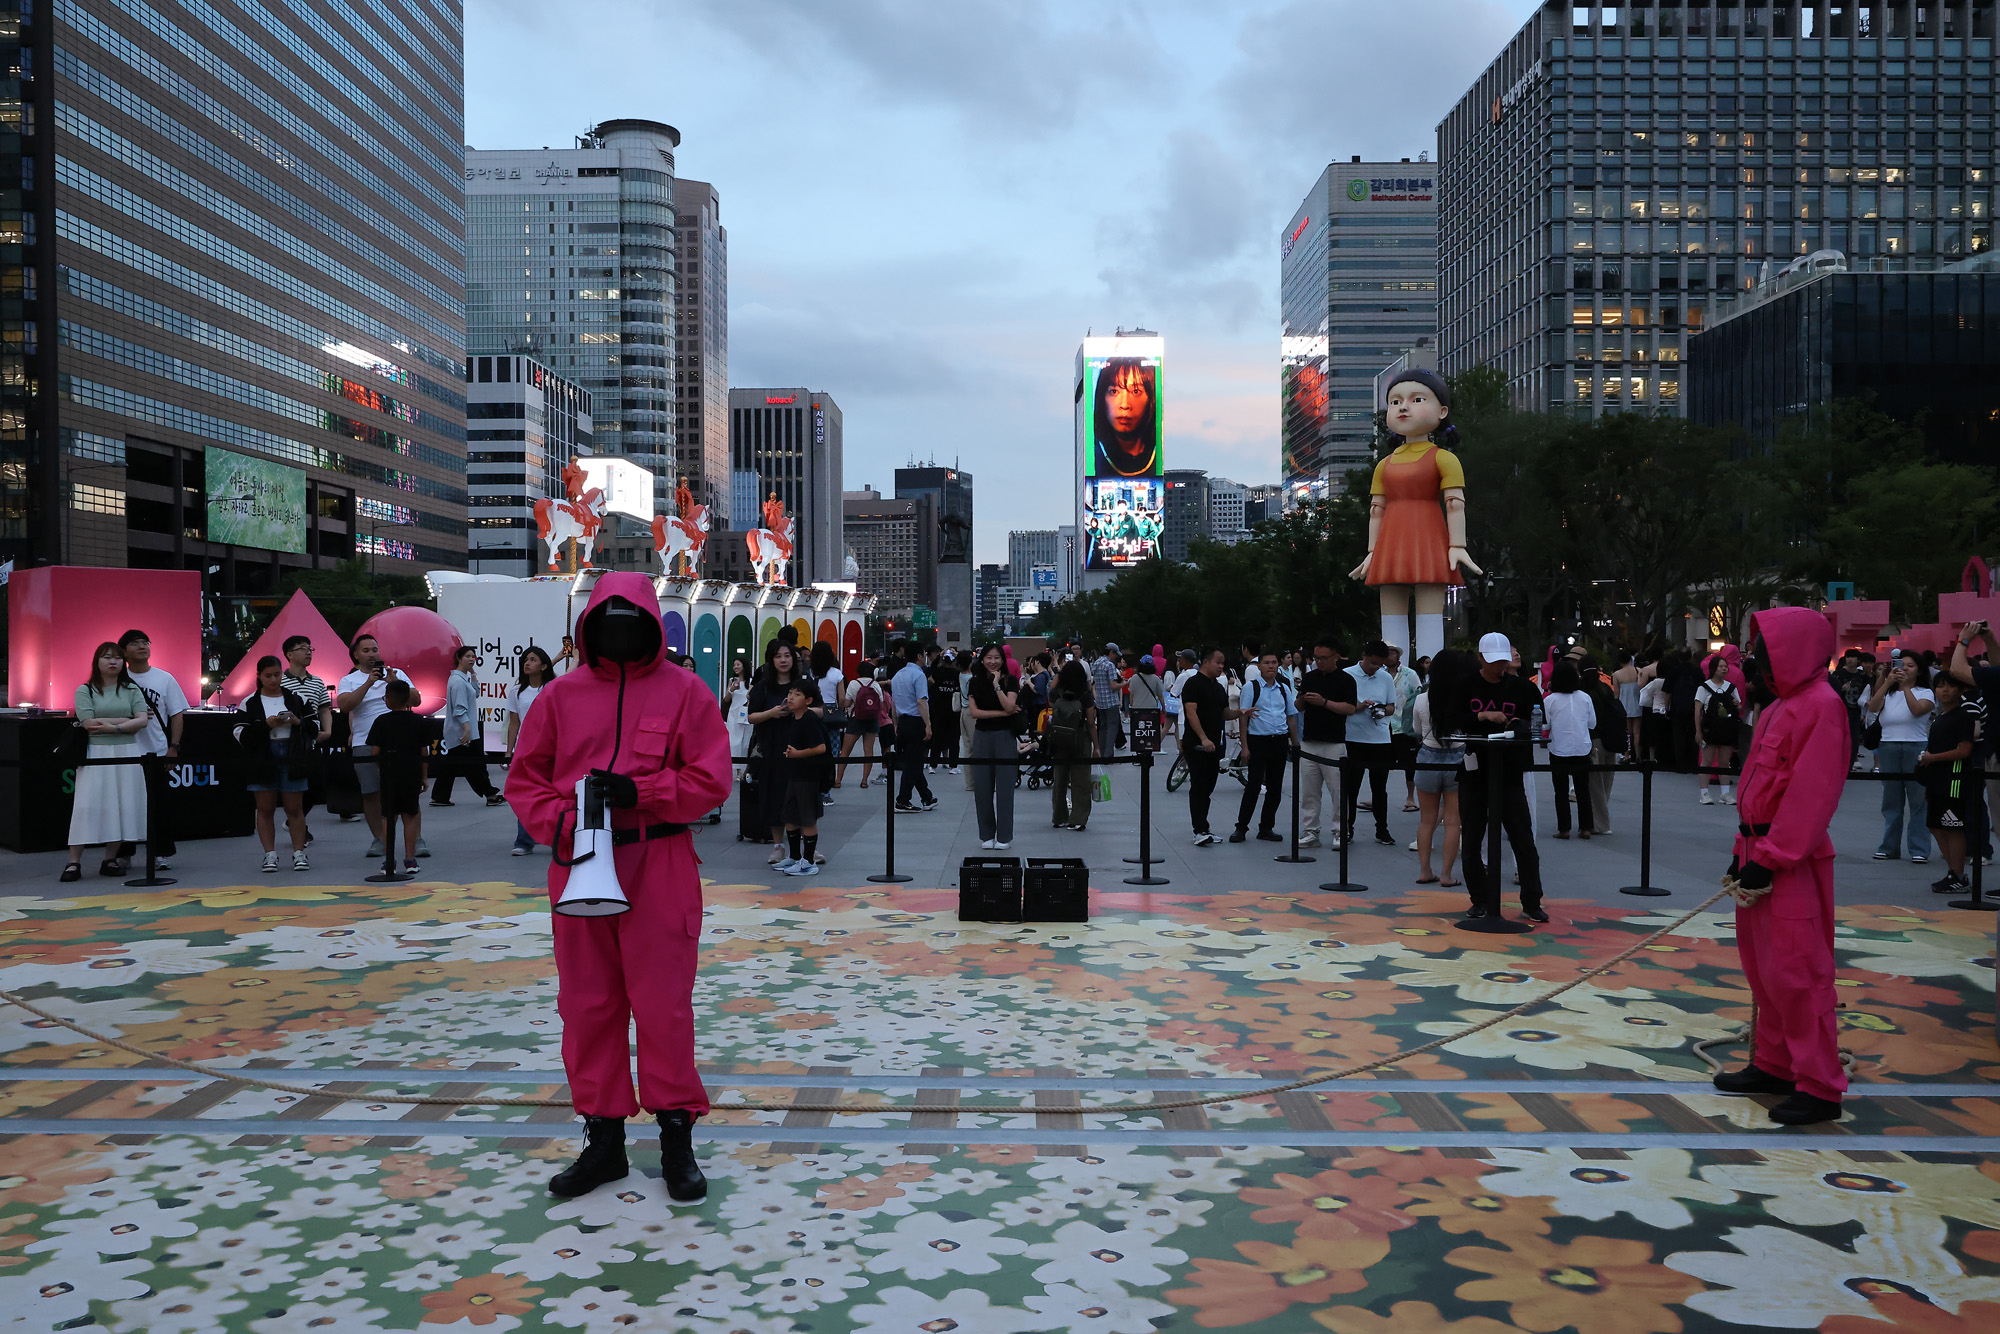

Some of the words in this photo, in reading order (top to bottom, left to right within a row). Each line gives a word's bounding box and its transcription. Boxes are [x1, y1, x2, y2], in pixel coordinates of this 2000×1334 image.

[535, 168, 573, 178] CHANNEL
[1408, 194, 1433, 202] Center
[766, 396, 793, 405] kobaco
[815, 410, 824, 444] 서울신문
[1038, 573, 1057, 582] 광고
[168, 764, 219, 788] SOUL
